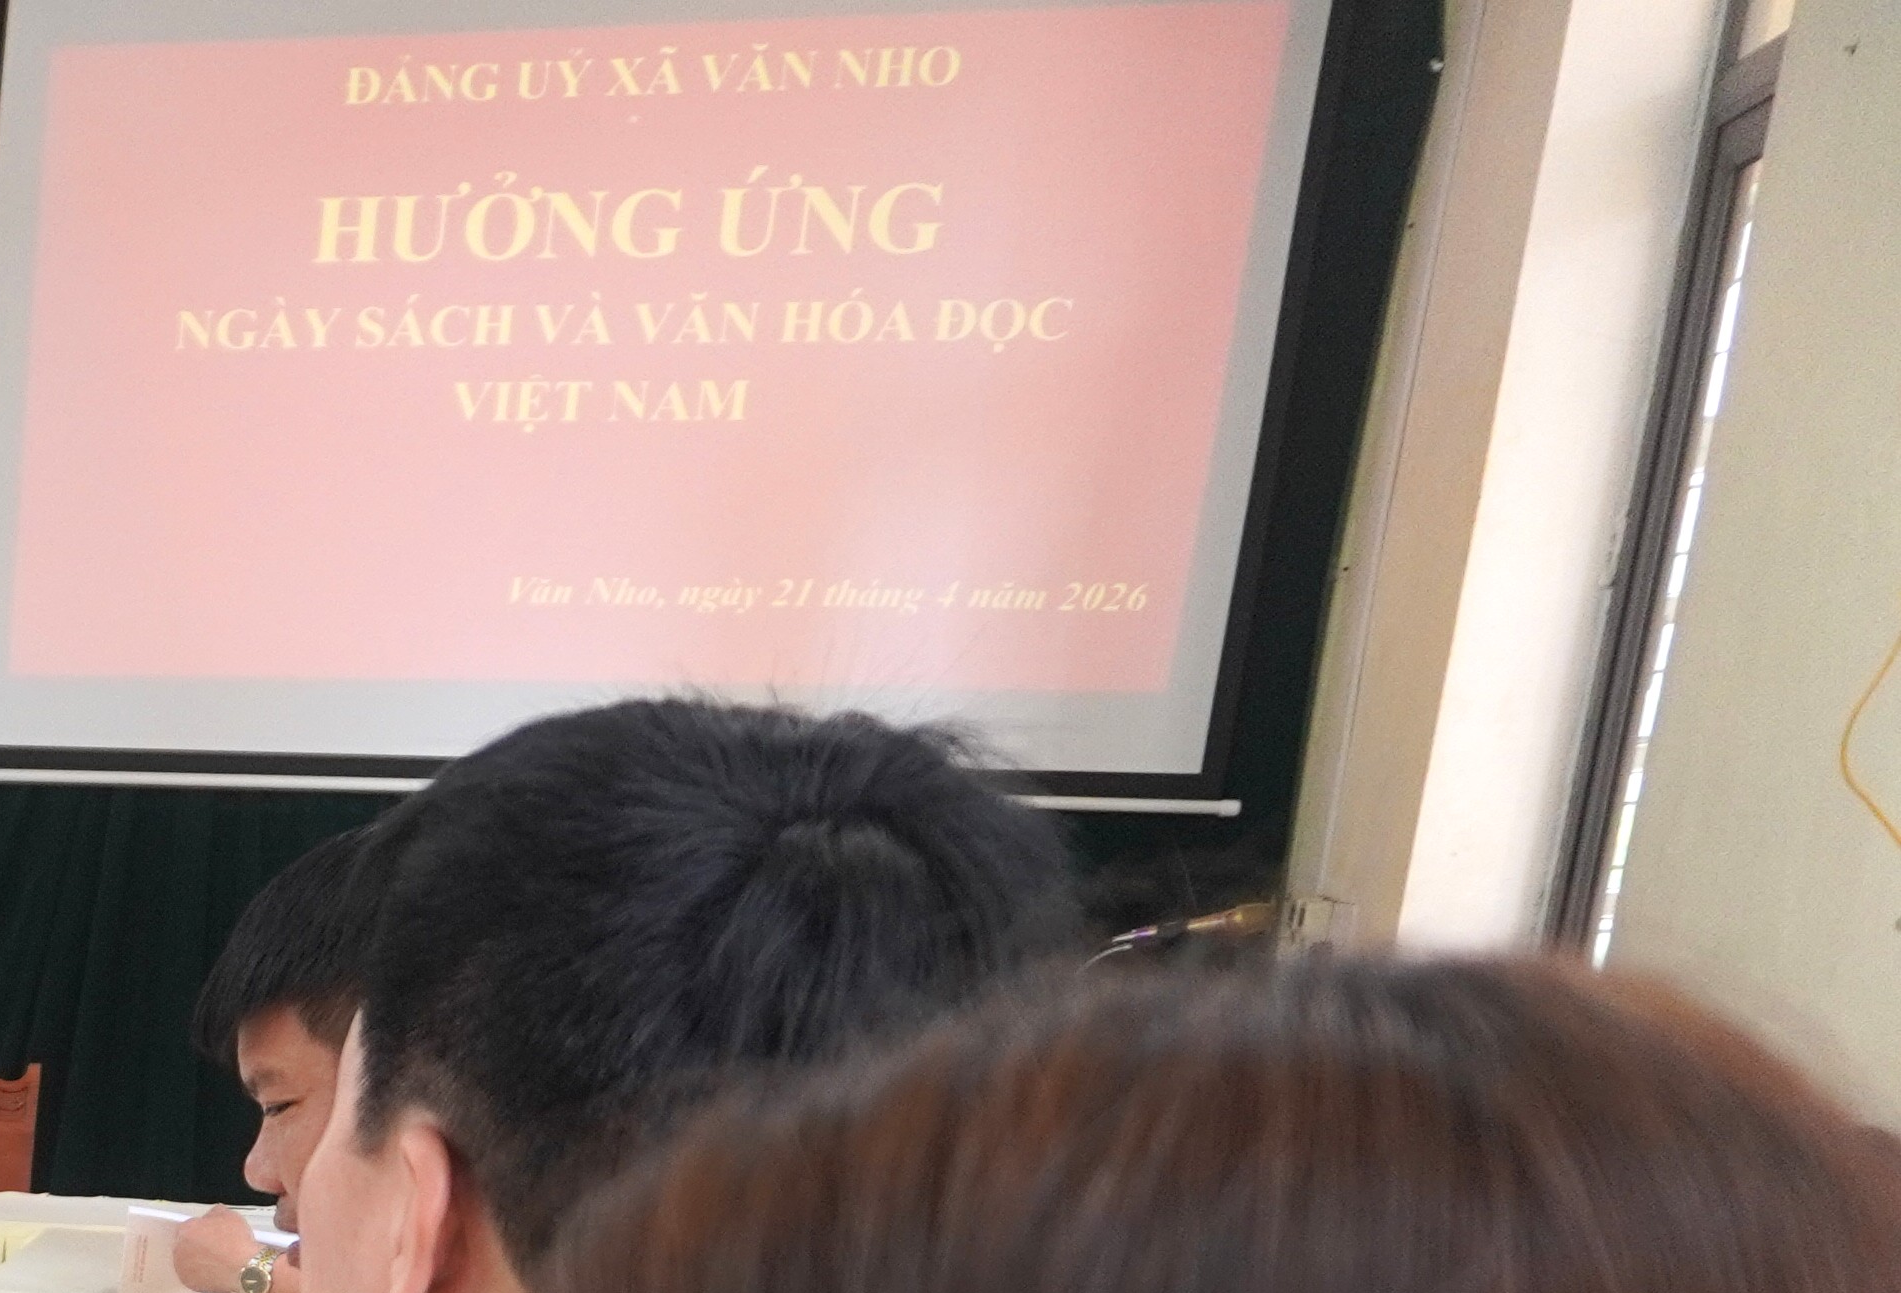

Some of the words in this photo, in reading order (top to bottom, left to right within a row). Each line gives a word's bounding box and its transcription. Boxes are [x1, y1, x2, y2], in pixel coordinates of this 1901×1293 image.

[345, 55, 499, 105] ĐẢNG
[605, 47, 683, 97] XÃ
[702, 43, 817, 92] VĂN
[834, 45, 963, 89] NHO
[312, 170, 684, 264] HƯỞNG
[718, 164, 946, 258] ỨNG
[175, 297, 342, 351] NGÀY
[354, 293, 515, 349] SÁCH
[534, 290, 613, 347] VÀ
[634, 290, 761, 345] VĂN
[781, 287, 916, 344] HÓA
[933, 297, 1076, 353] ĐỌC
[453, 373, 592, 433] VIỆT
[608, 379, 751, 424] NAM
[508, 575, 572, 606] Văn
[584, 575, 665, 607] Nho,
[677, 577, 763, 614] ngày
[771, 577, 809, 609] 21
[823, 577, 924, 613] tháng
[937, 580, 956, 610] 4
[966, 581, 1047, 611] năm
[1057, 580, 1149, 612] 2026
